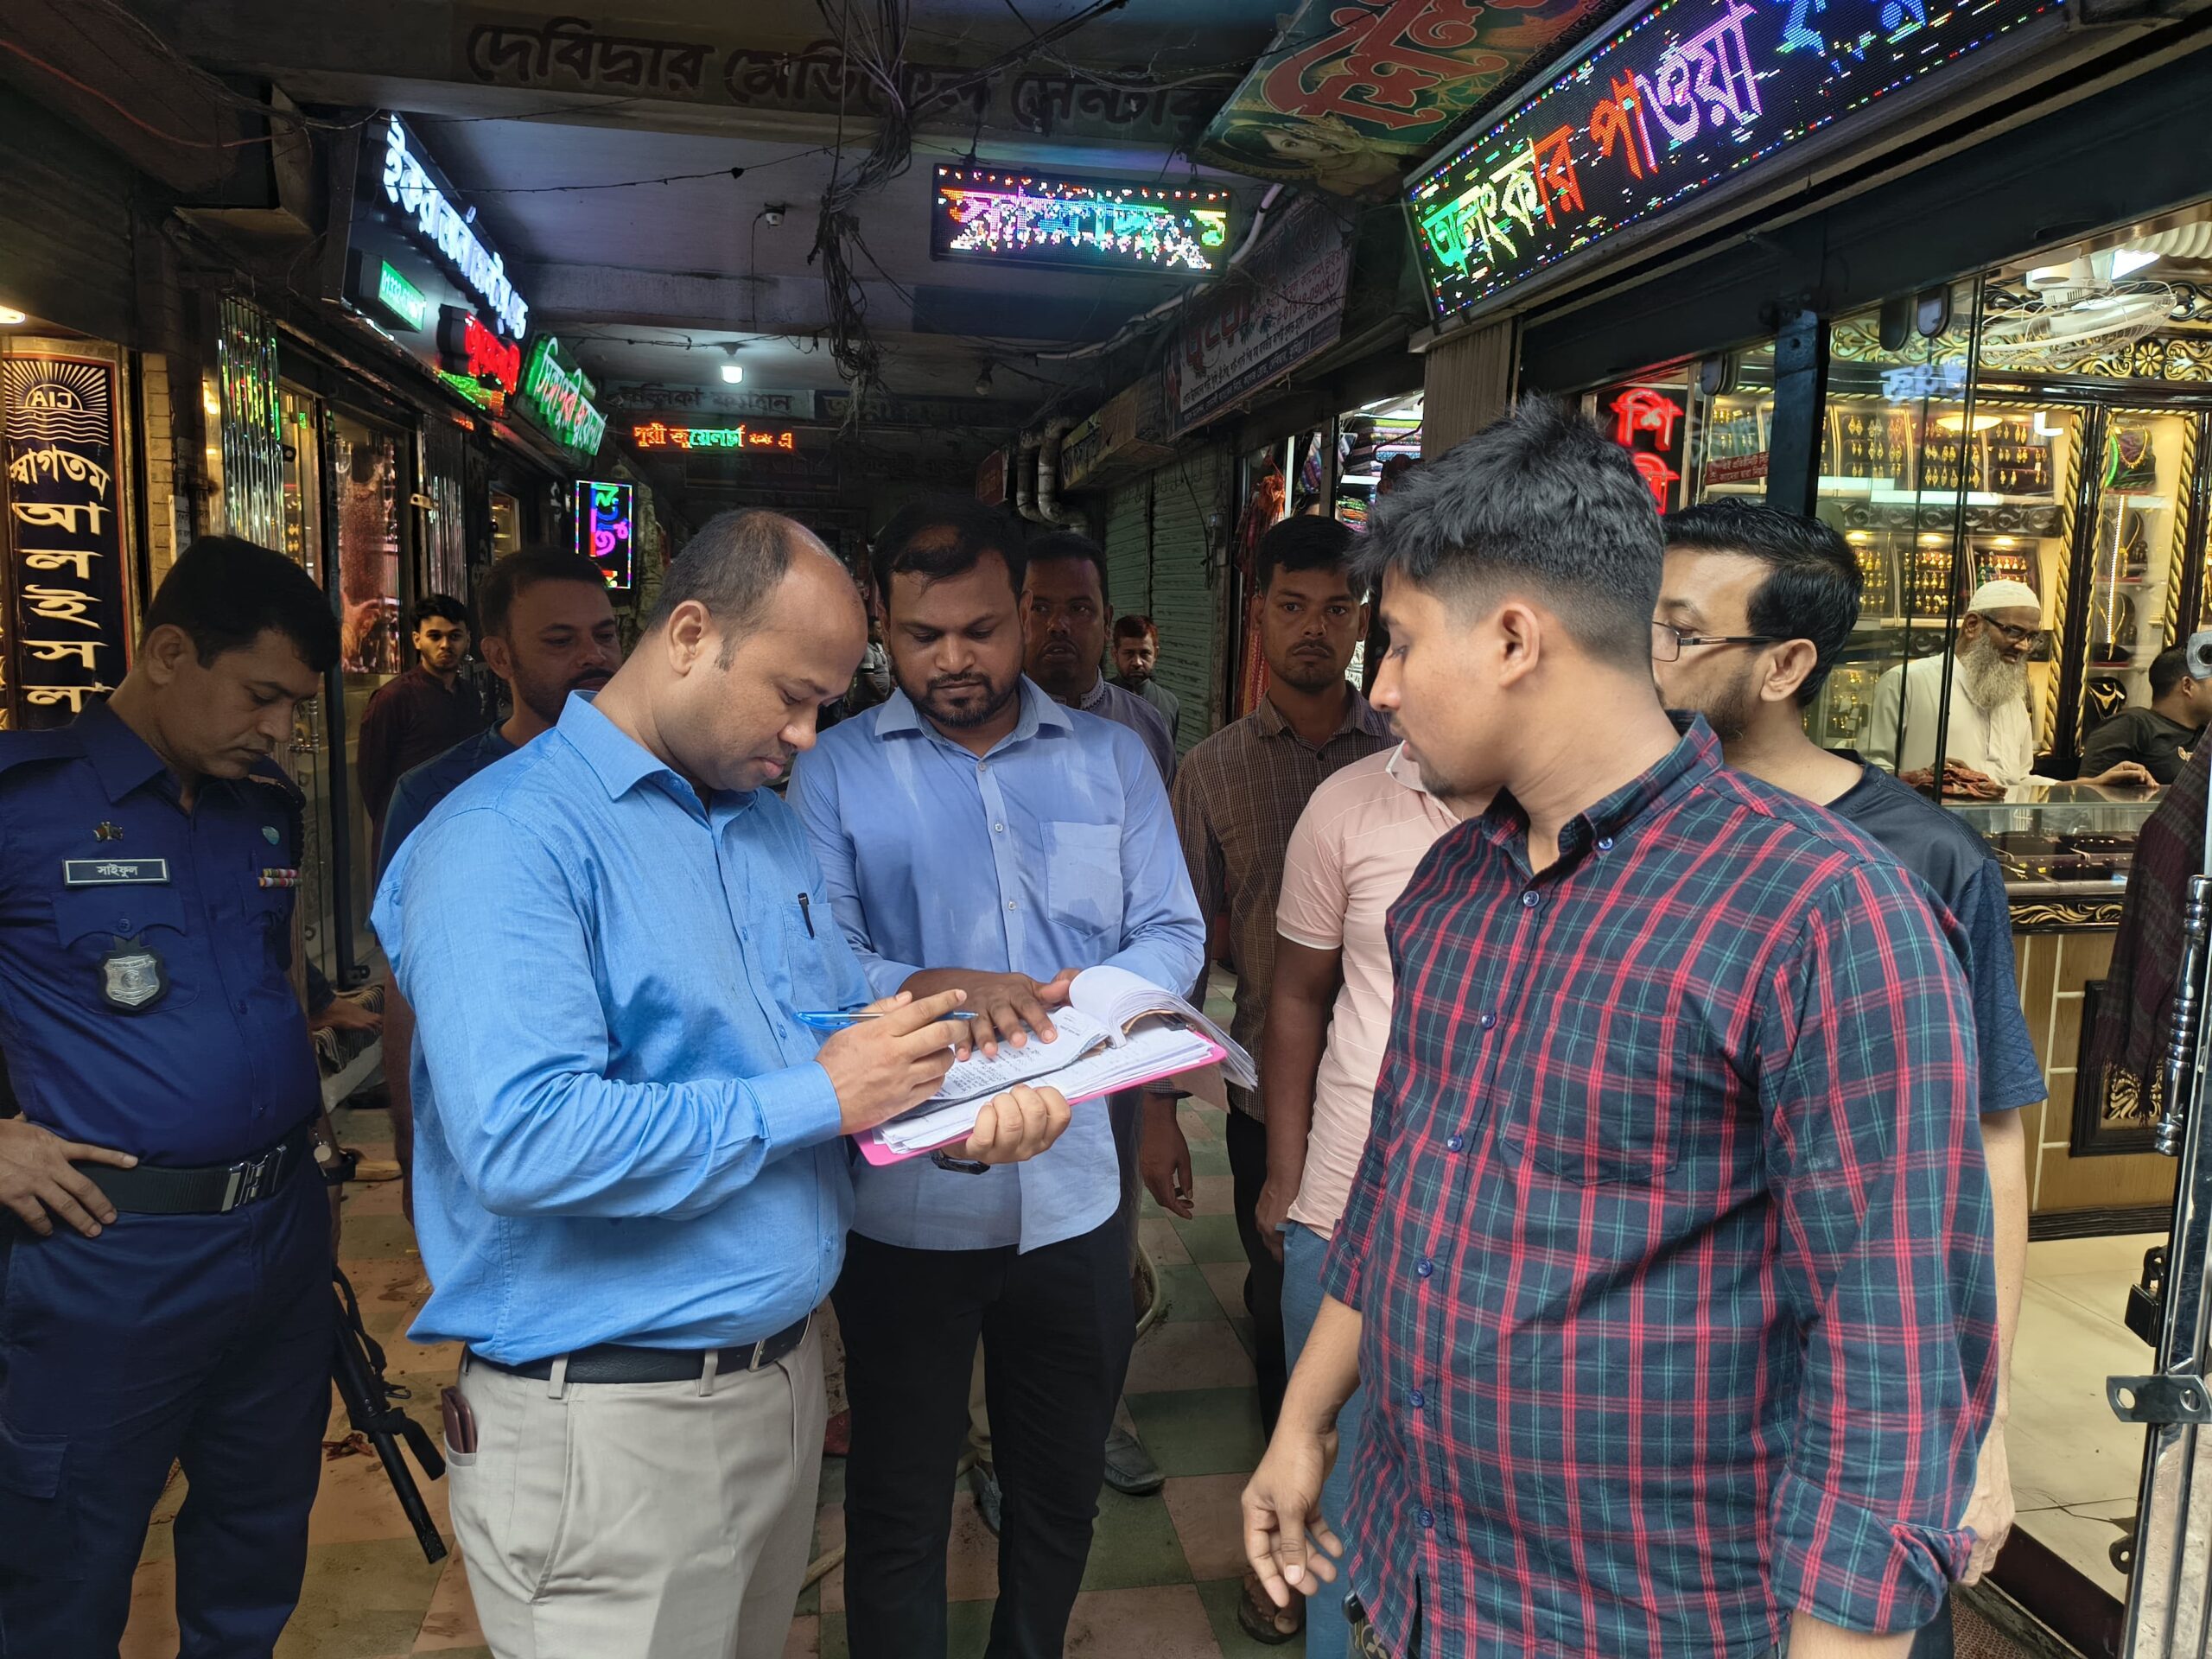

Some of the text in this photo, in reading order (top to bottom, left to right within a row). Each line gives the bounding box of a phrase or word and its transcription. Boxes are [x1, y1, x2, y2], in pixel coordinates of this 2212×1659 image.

[467, 16, 715, 92] দেবিদ্বার
[10, 444, 111, 501] স্বাগতম
[96, 863, 138, 878] সাইফুল
